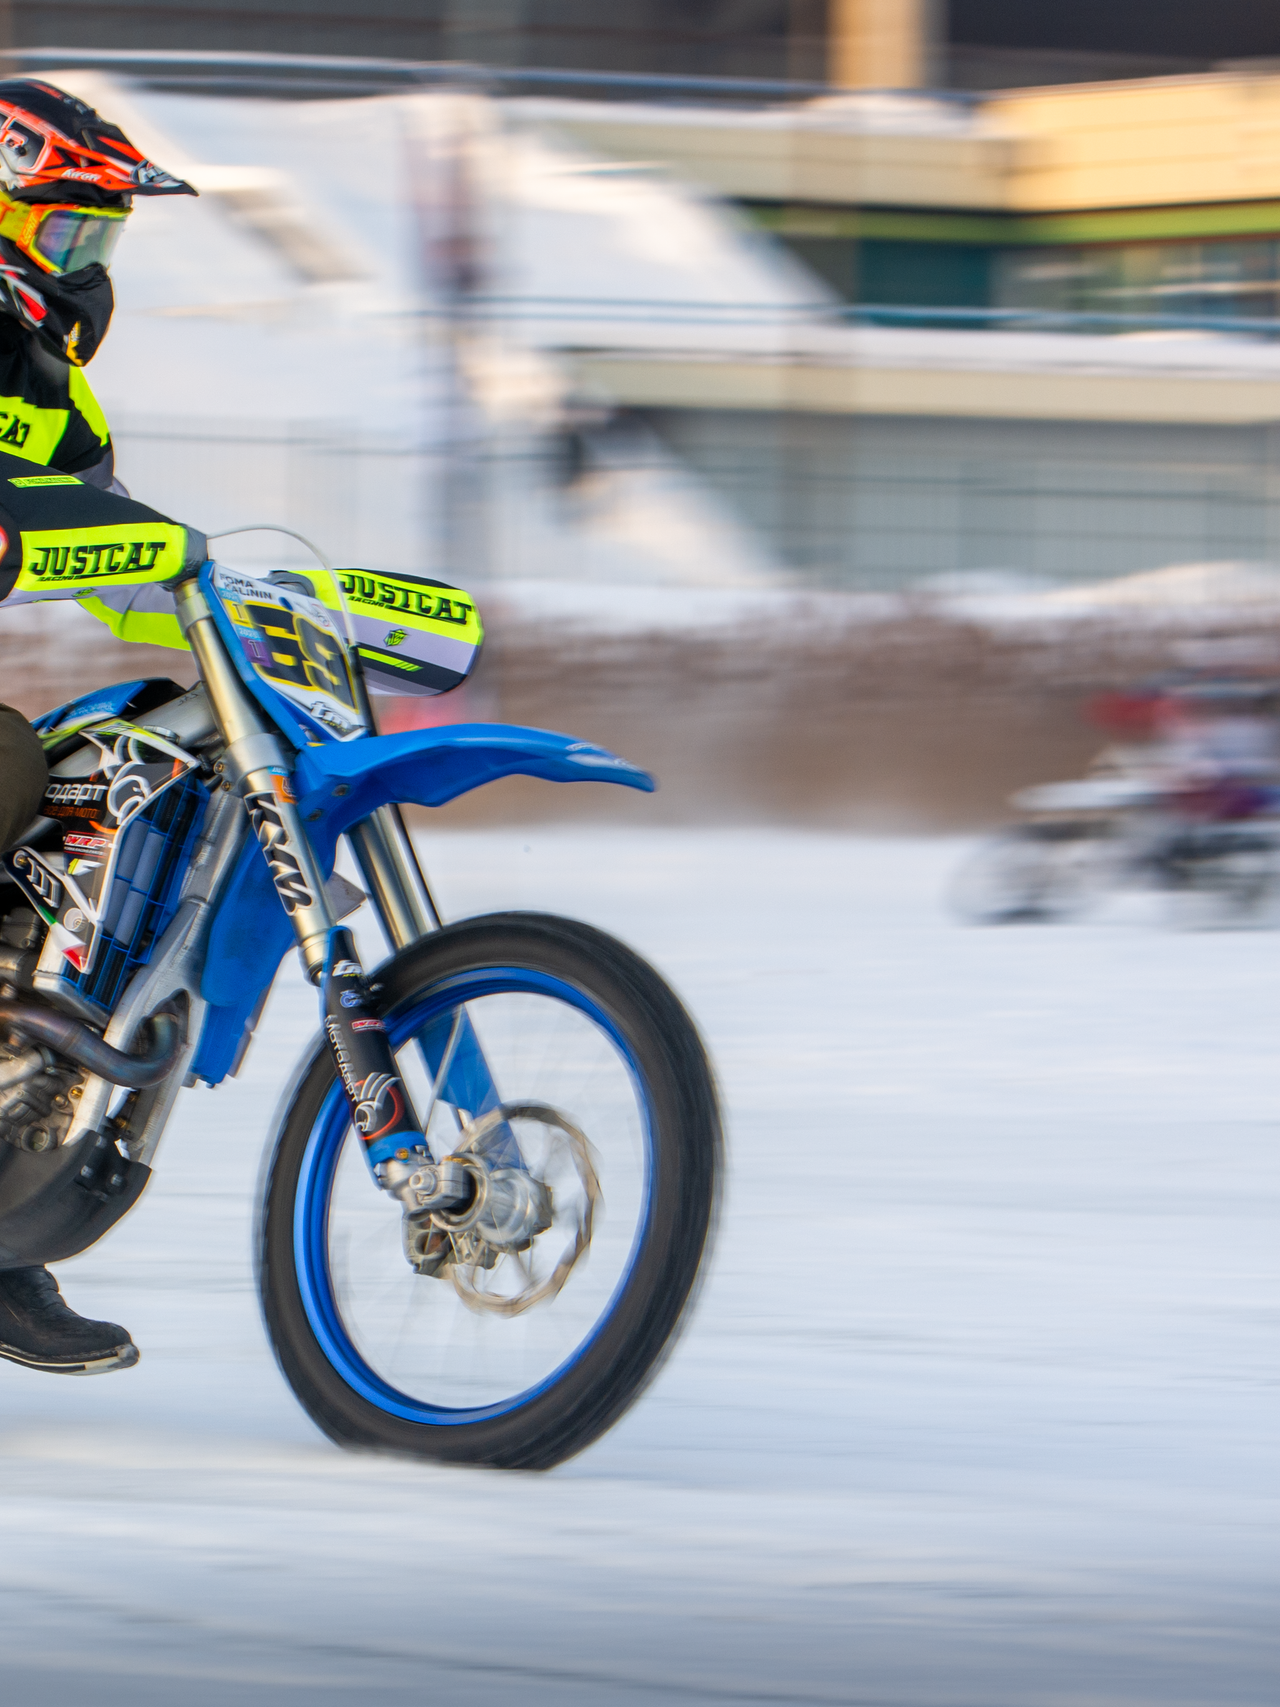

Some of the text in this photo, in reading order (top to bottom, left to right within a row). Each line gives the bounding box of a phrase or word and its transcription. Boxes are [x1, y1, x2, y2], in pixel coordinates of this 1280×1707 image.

[28, 541, 167, 576] JUSTCAT
[36, 574, 82, 582] RACING
[219, 573, 254, 589] FOMA
[224, 583, 273, 600] KALININ
[337, 573, 472, 625] JUSTCAT
[347, 595, 385, 608] RACING
[246, 603, 359, 714] 69
[64, 833, 109, 850] WRP
[243, 791, 316, 917] KYB
